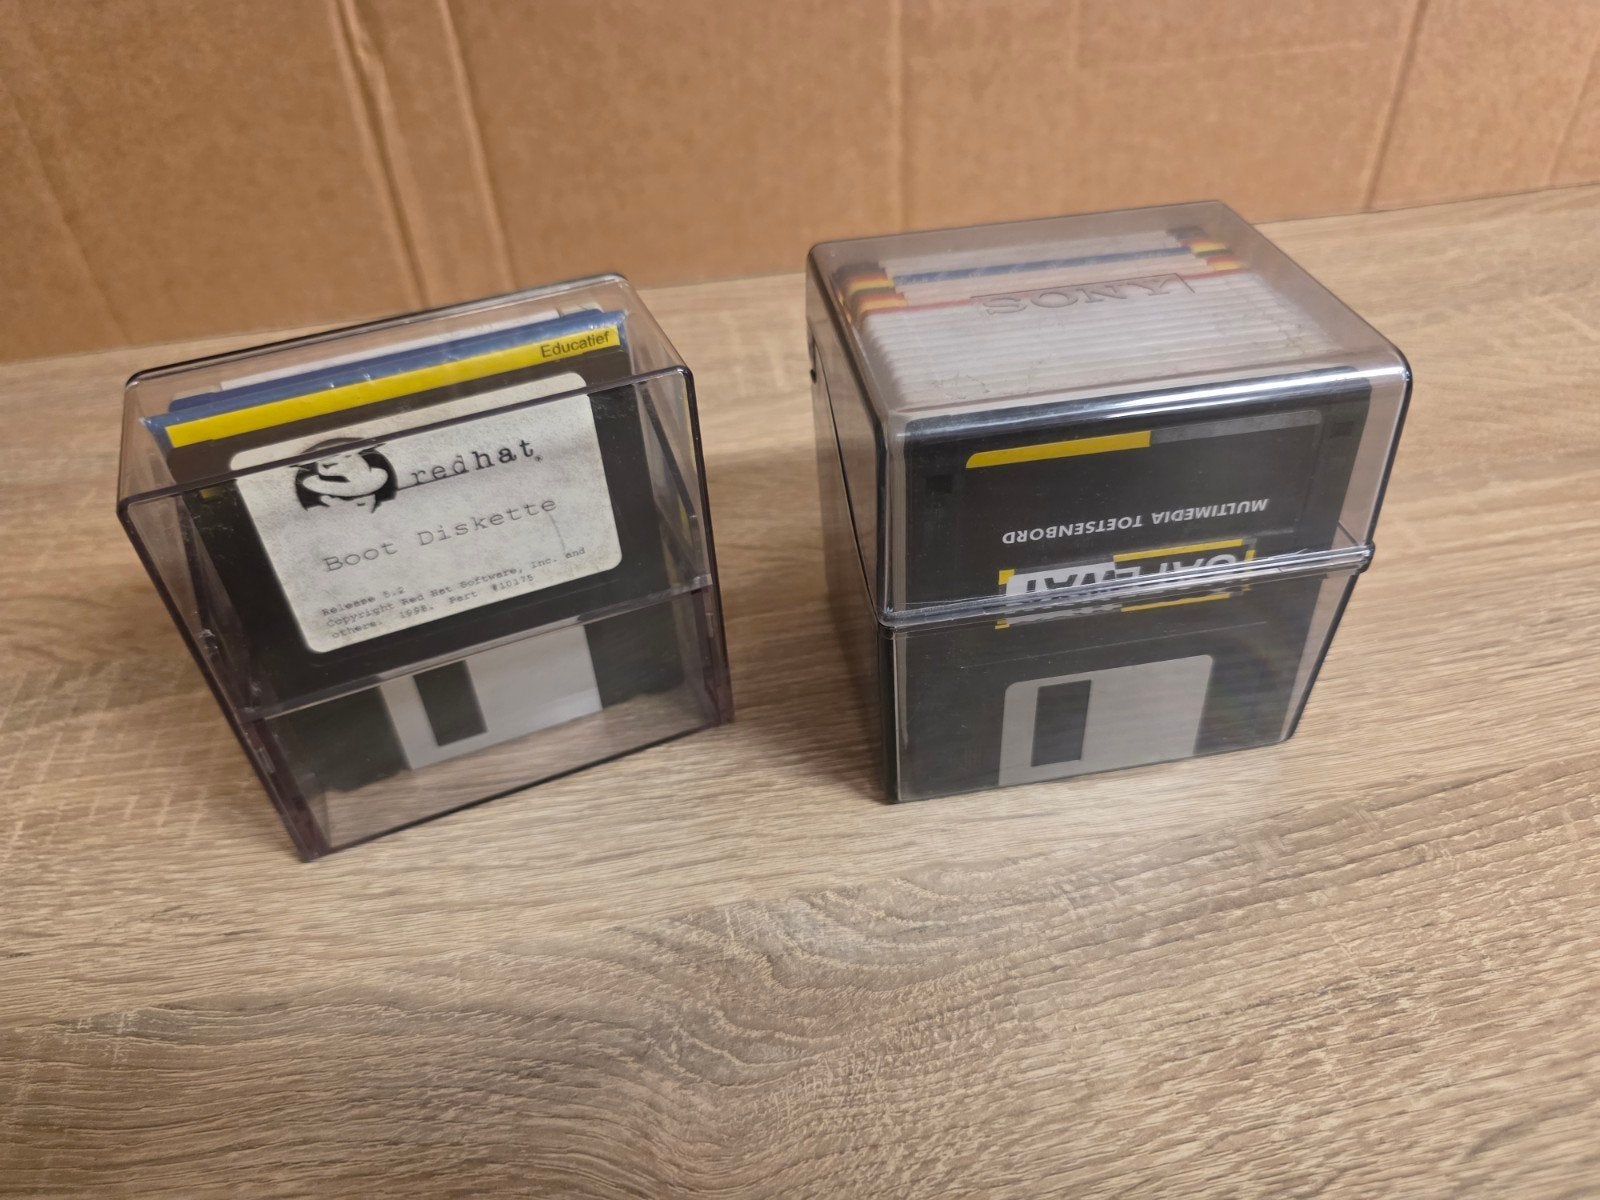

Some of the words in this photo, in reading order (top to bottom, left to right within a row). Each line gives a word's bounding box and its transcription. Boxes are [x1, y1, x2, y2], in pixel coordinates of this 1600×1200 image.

[982, 277, 1176, 316] SONY
[540, 330, 610, 358] Educatief
[1151, 498, 1270, 525] MULTIMEDIA
[323, 541, 399, 573] Boot
[416, 499, 558, 547] Diskette
[1001, 515, 1143, 544] TOETSENBORD
[326, 602, 395, 628] Copyright
[401, 593, 425, 606] Red
[429, 585, 453, 598] Hat
[565, 546, 586, 560] and
[448, 590, 479, 605] Part
[321, 596, 376, 617] Release
